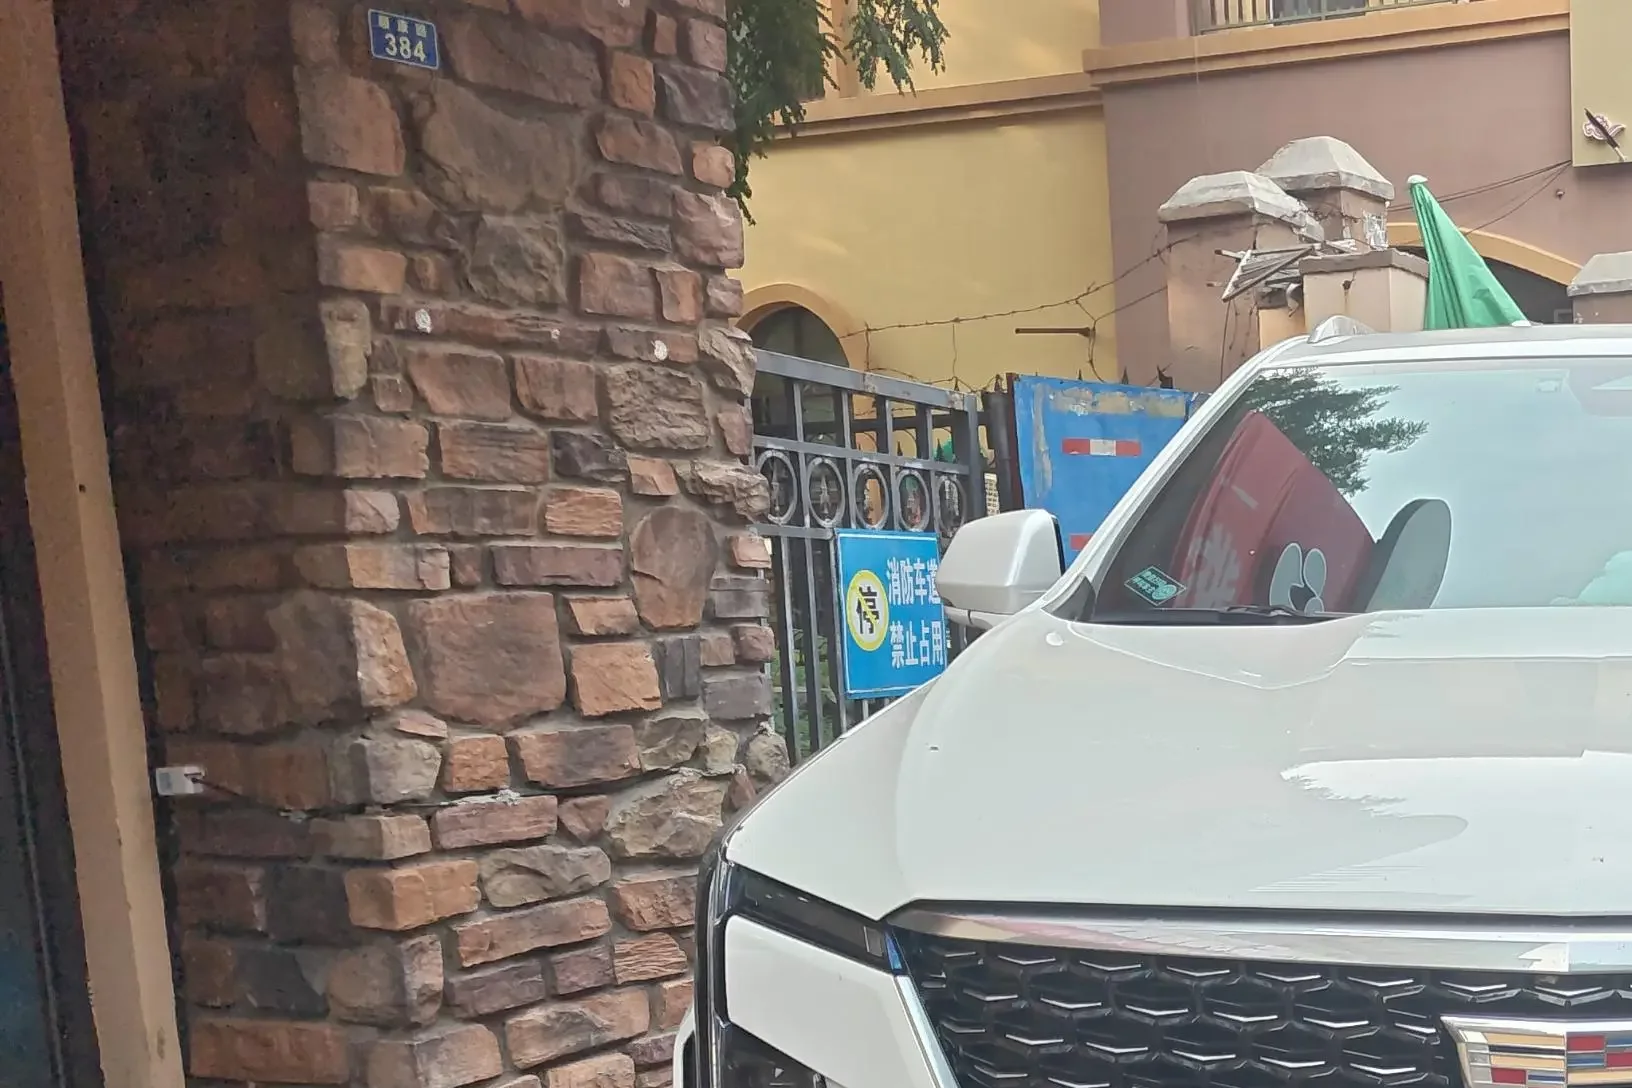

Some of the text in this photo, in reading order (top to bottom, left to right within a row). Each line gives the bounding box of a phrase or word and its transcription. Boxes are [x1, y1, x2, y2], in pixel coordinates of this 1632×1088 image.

[384, 33, 427, 62] 384
[886, 557, 941, 605] 消防车道
[856, 586, 880, 634] 停
[890, 620, 944, 668] 禁止占用
